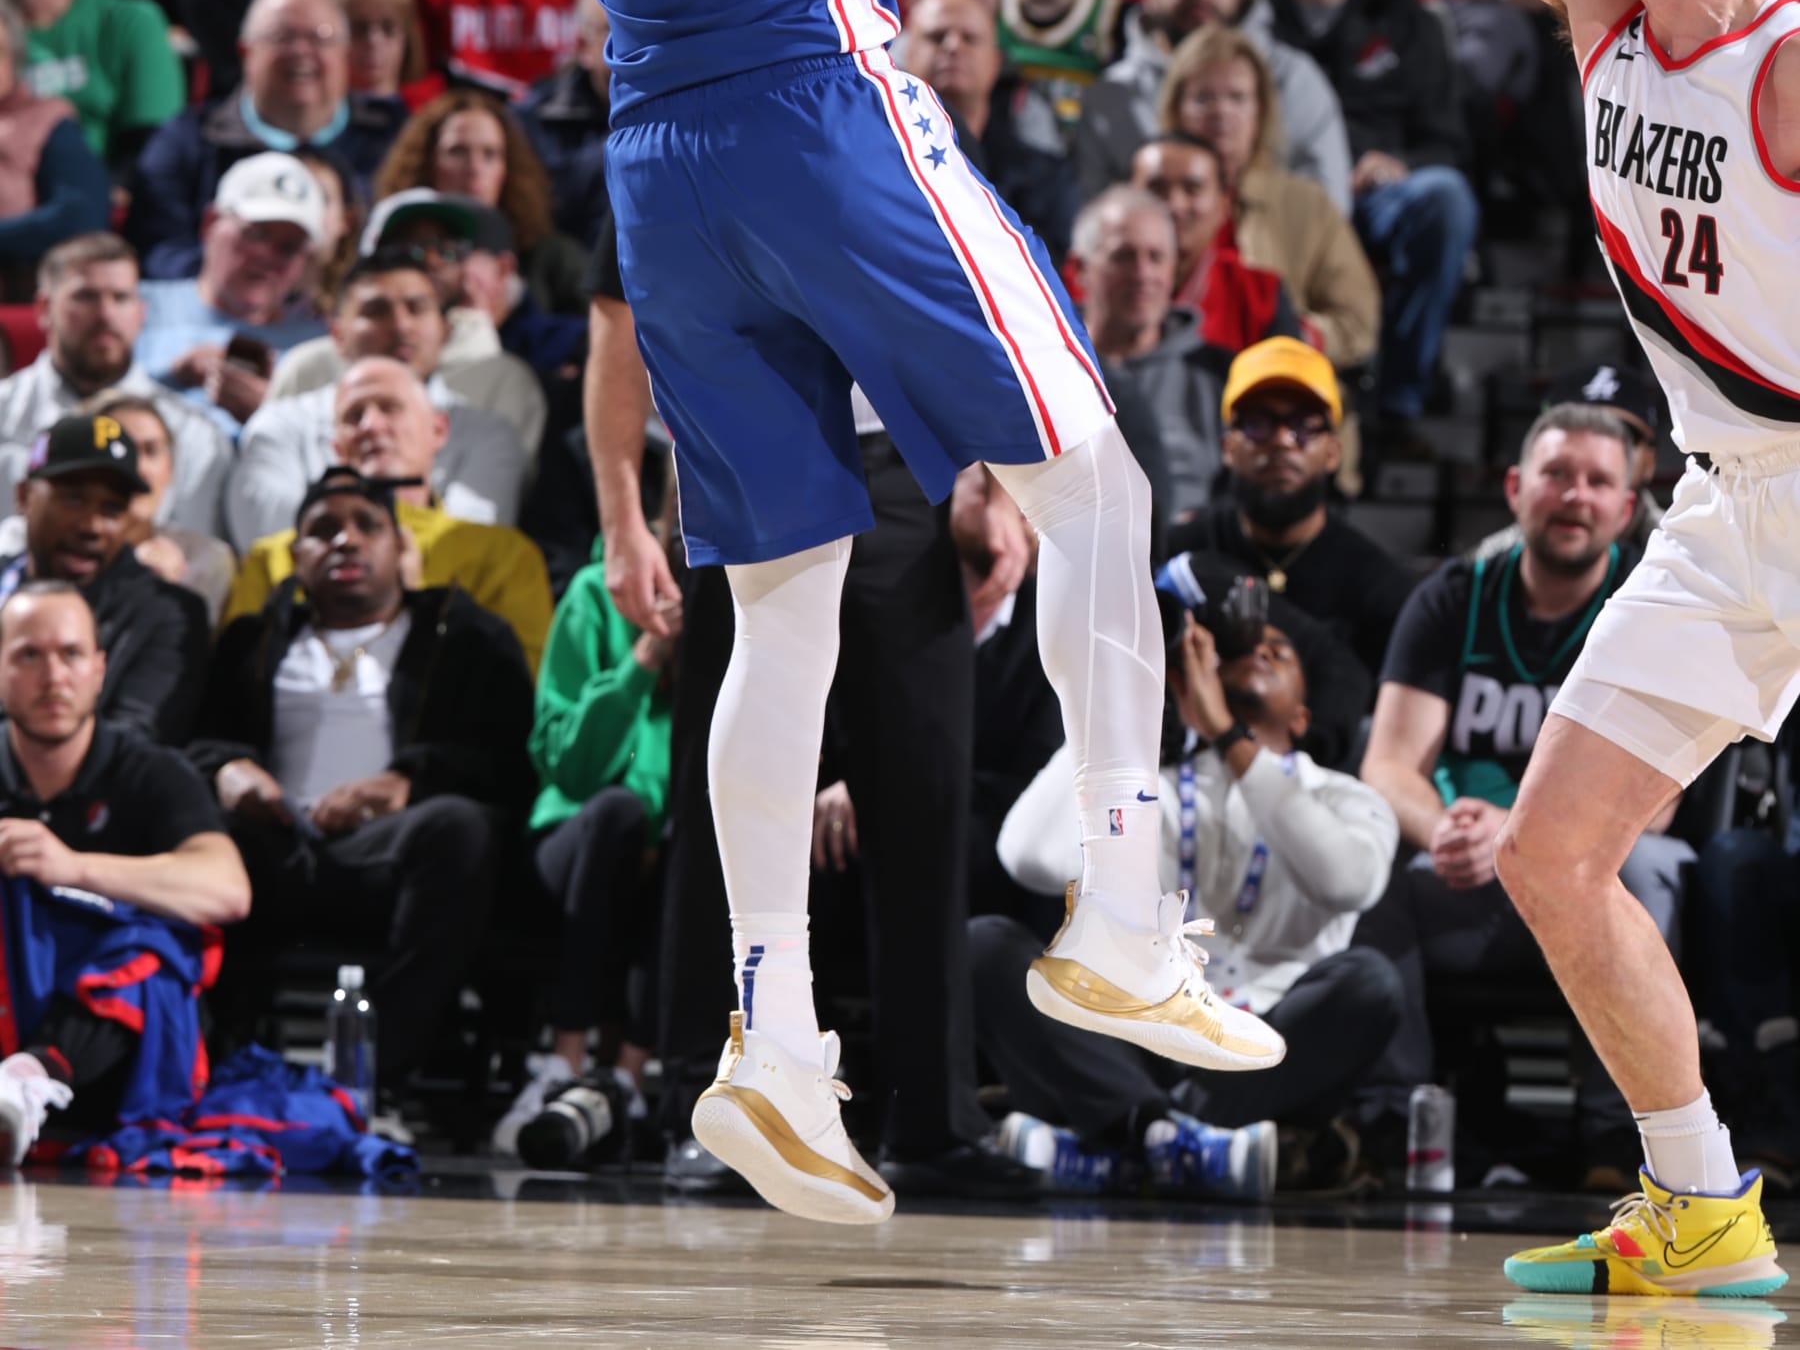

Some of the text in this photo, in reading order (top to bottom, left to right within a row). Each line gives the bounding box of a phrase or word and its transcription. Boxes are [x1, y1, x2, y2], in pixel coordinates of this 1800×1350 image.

[1594, 97, 1728, 204] BLAZERS
[1660, 207, 1724, 295] 24
[93, 415, 121, 449] P
